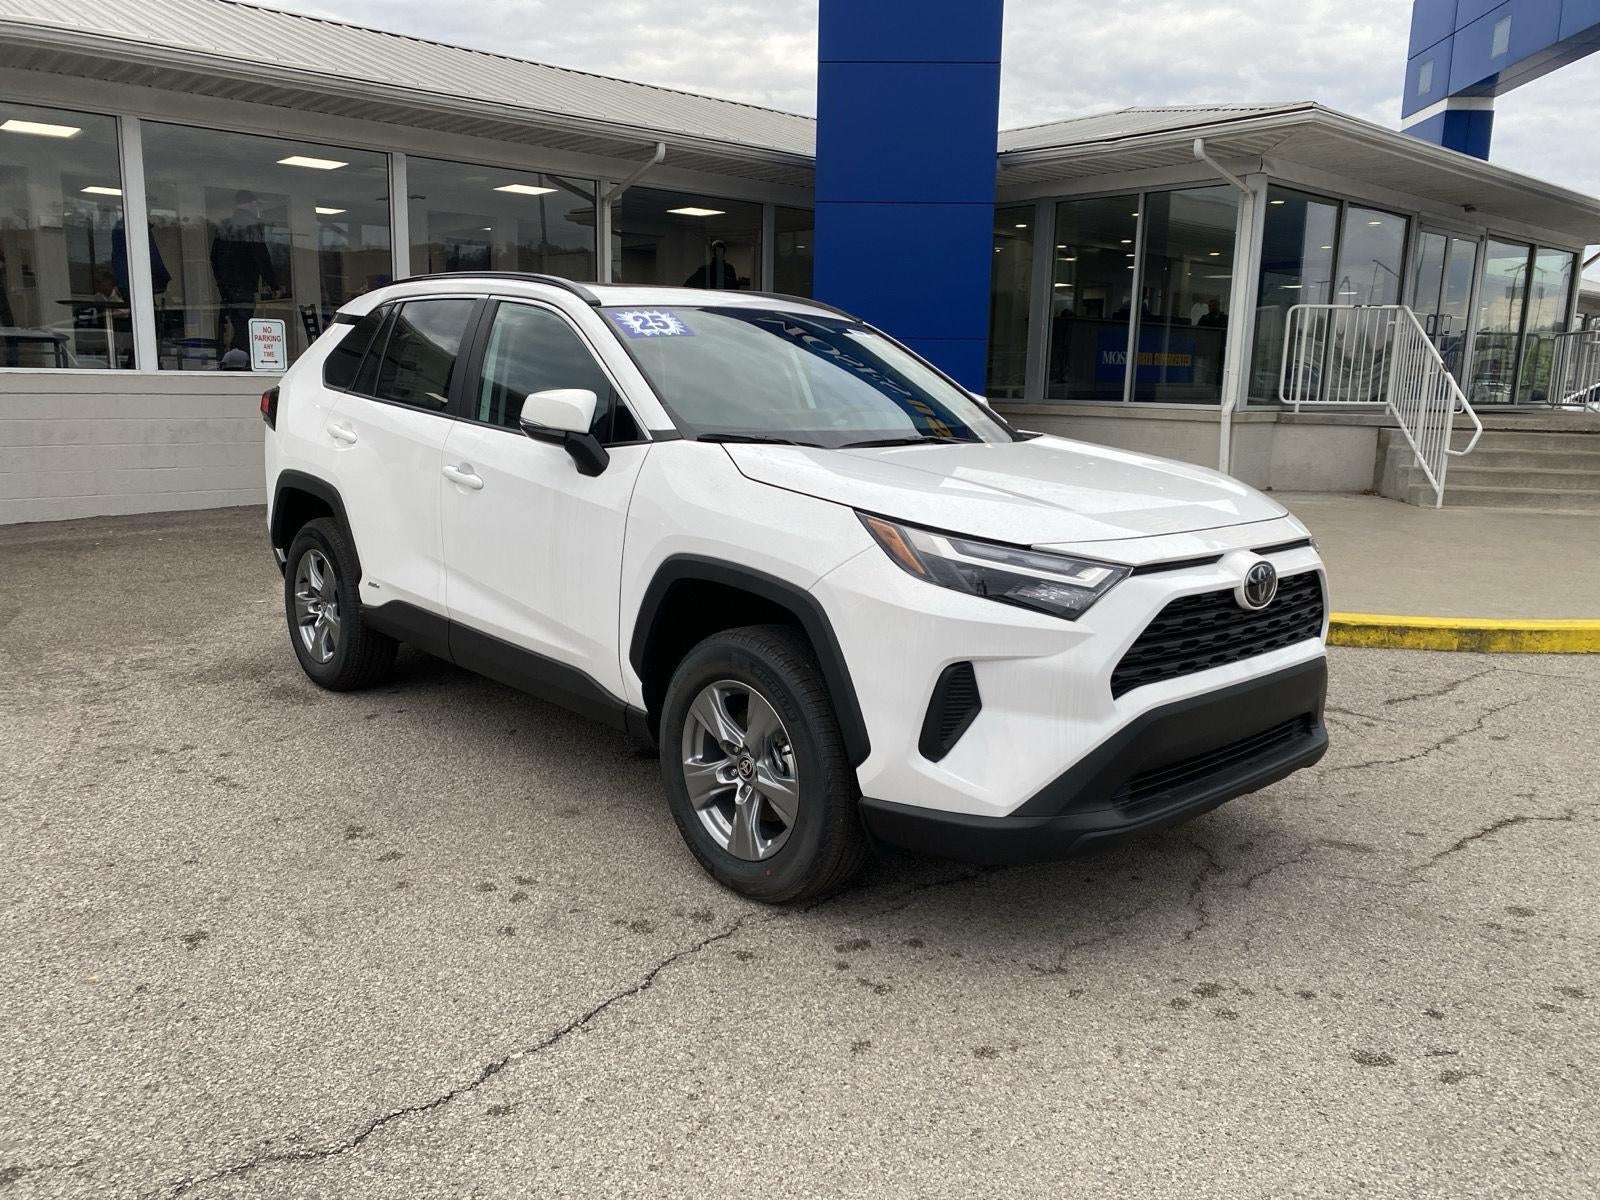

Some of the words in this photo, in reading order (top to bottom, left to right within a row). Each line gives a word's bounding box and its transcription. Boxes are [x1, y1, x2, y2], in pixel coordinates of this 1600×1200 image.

[632, 315, 670, 330] 25
[262, 326, 272, 334] NO
[254, 334, 282, 342] PARKING
